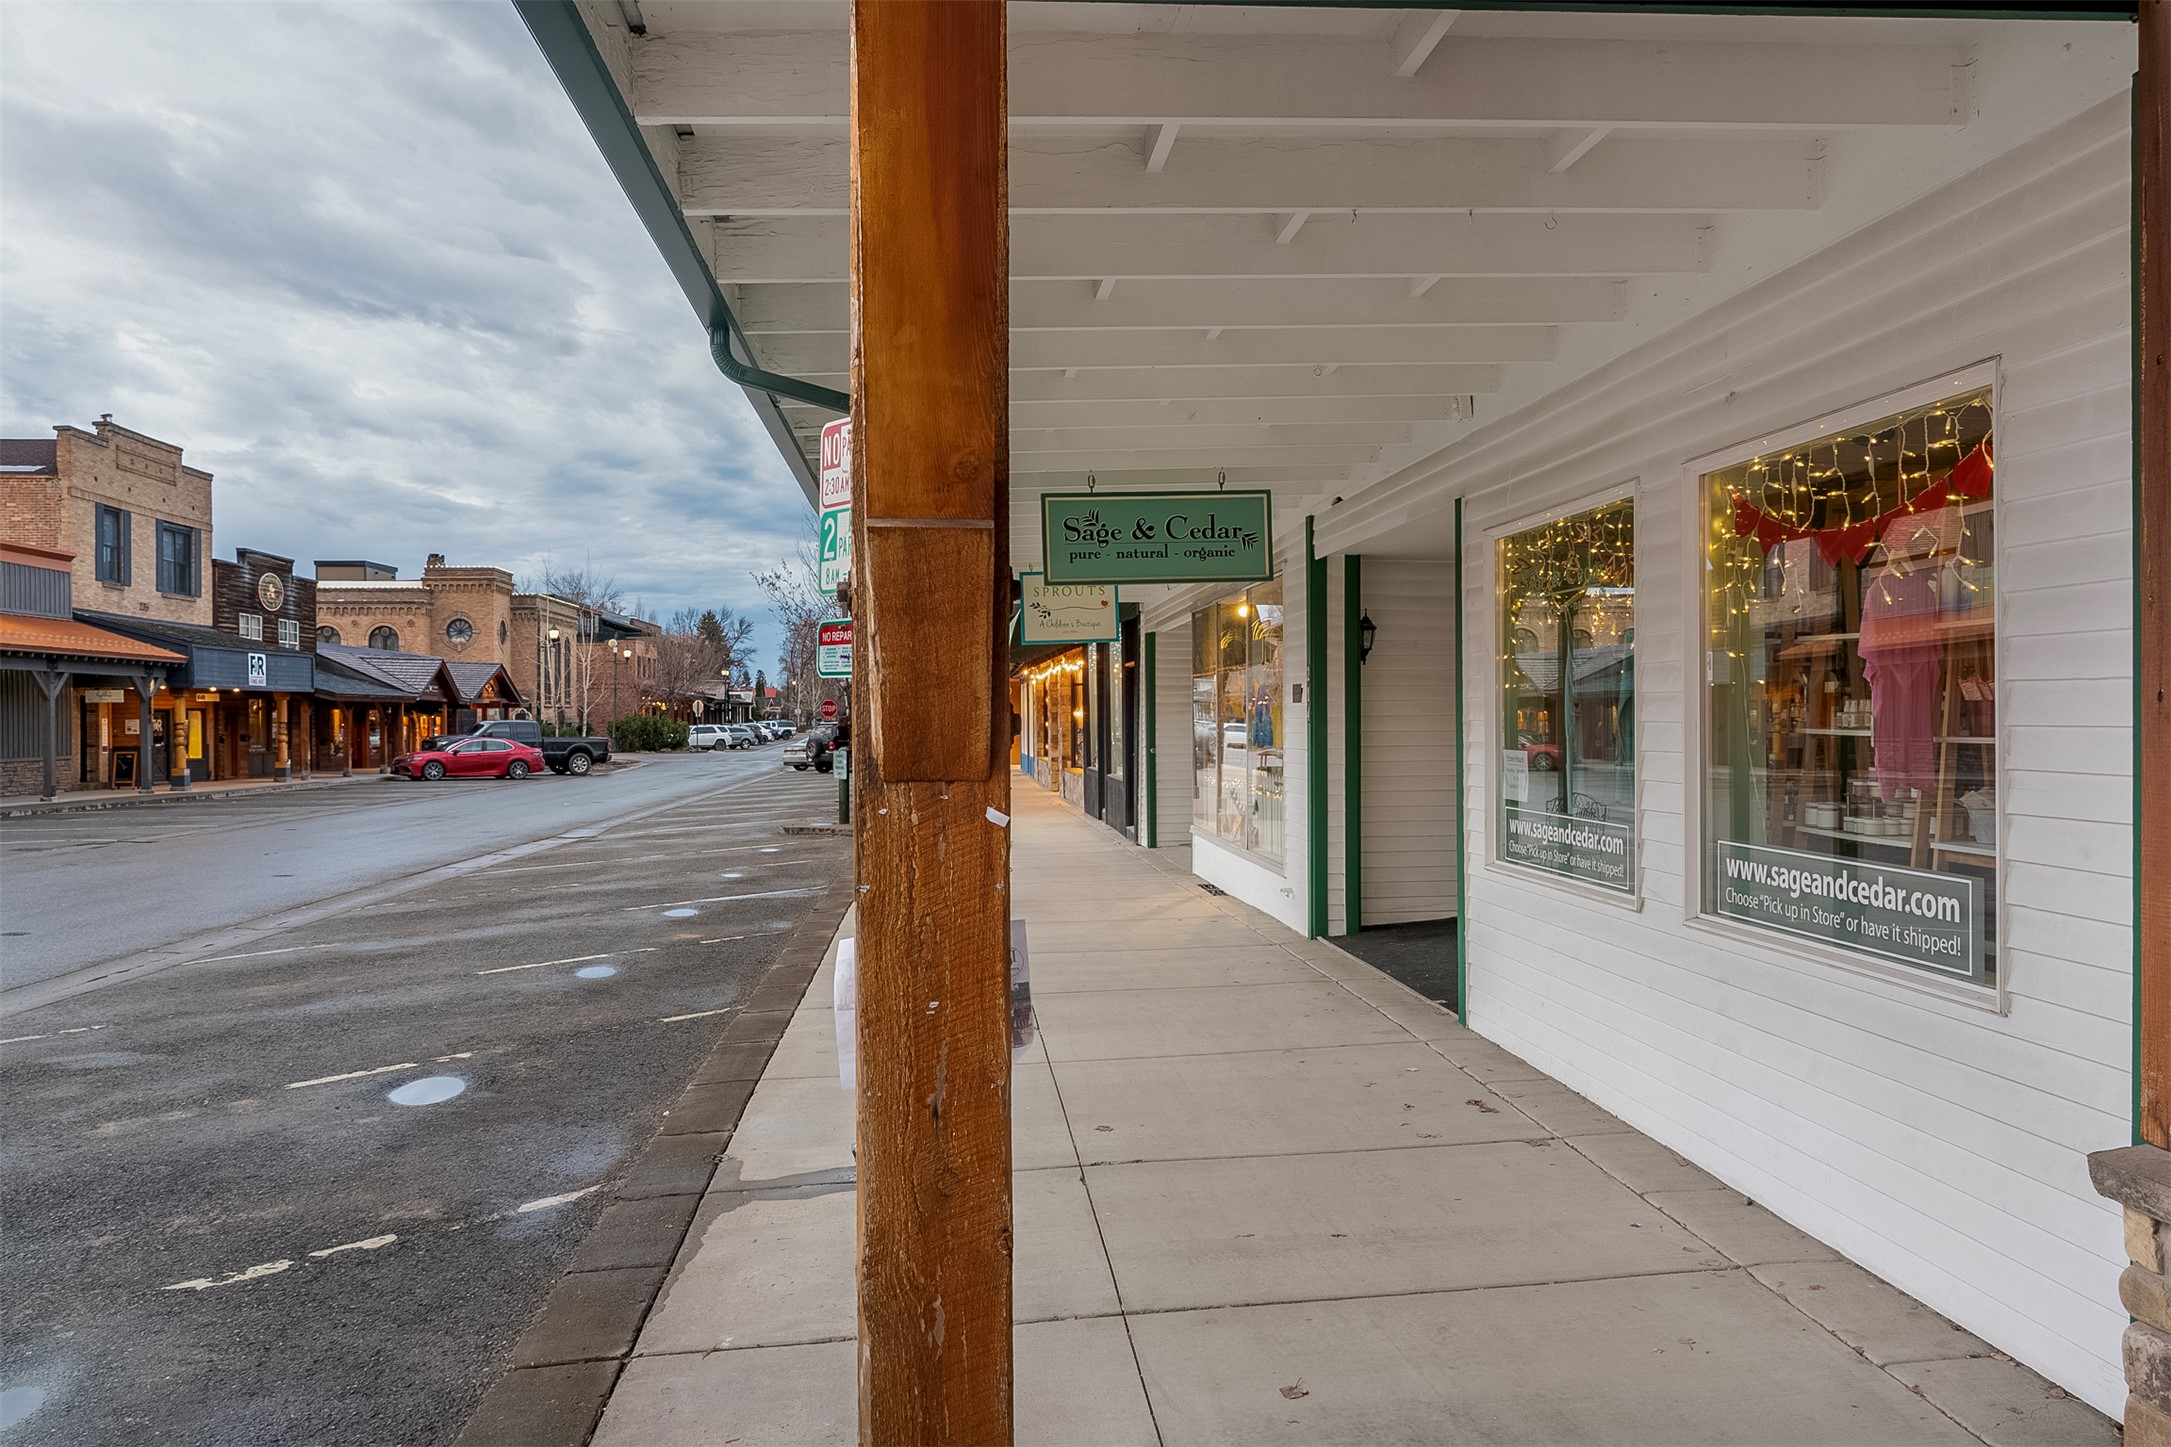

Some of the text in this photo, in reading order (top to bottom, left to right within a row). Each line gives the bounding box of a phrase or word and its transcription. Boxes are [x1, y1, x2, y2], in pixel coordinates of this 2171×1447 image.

[824, 433, 840, 467] NO
[824, 517, 835, 559] 2
[1062, 513, 1243, 548] Sage & Cedar
[1069, 551, 1102, 563] pure
[1115, 544, 1169, 559] natural
[1183, 545, 1236, 561] organic
[1033, 585, 1106, 597] SPROUTS
[822, 632, 831, 642] NO
[1040, 620, 1045, 628] A
[1076, 619, 1101, 630] Boutique
[1509, 819, 1624, 855] www.sageandcedar.com
[1508, 840, 1527, 856] Choose
[1540, 850, 1547, 862] up
[1548, 849, 1553, 860] in
[1570, 856, 1576, 866] or
[1577, 855, 1591, 871] have
[1591, 858, 1596, 872] it
[1597, 860, 1624, 877] shipped!
[1726, 857, 1960, 923] www.sageandcedar.com
[1725, 886, 1759, 909] Choose
[1785, 905, 1798, 921] up
[1800, 903, 1810, 921] in
[1846, 917, 1858, 932] or
[1861, 915, 1889, 940] have
[1892, 923, 1901, 942] it
[1904, 928, 1961, 956] shipped!
